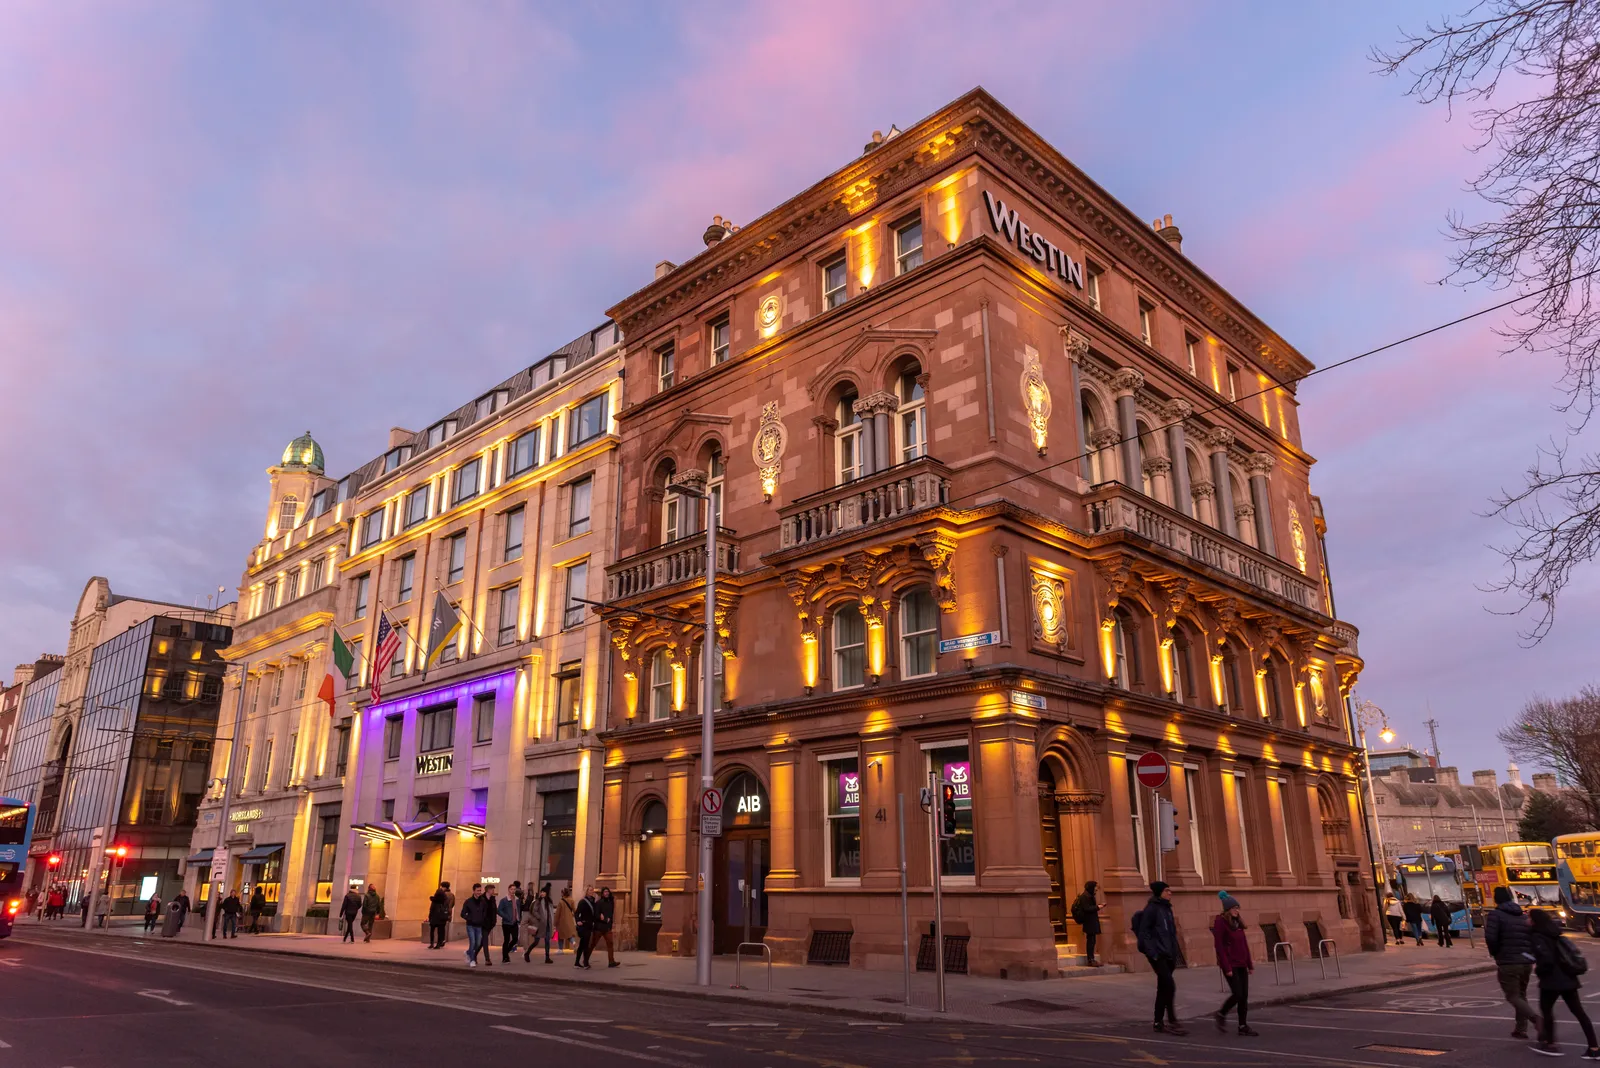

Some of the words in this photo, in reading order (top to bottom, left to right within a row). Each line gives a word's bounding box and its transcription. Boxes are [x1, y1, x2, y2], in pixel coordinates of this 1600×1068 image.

[982, 190, 1083, 290] WESTIN
[416, 754, 453, 774] WESTIN
[844, 793, 860, 804] AIB
[952, 784, 969, 796] AIB
[737, 796, 761, 813] AIB
[875, 808, 887, 822] 41
[947, 846, 974, 864] AIB
